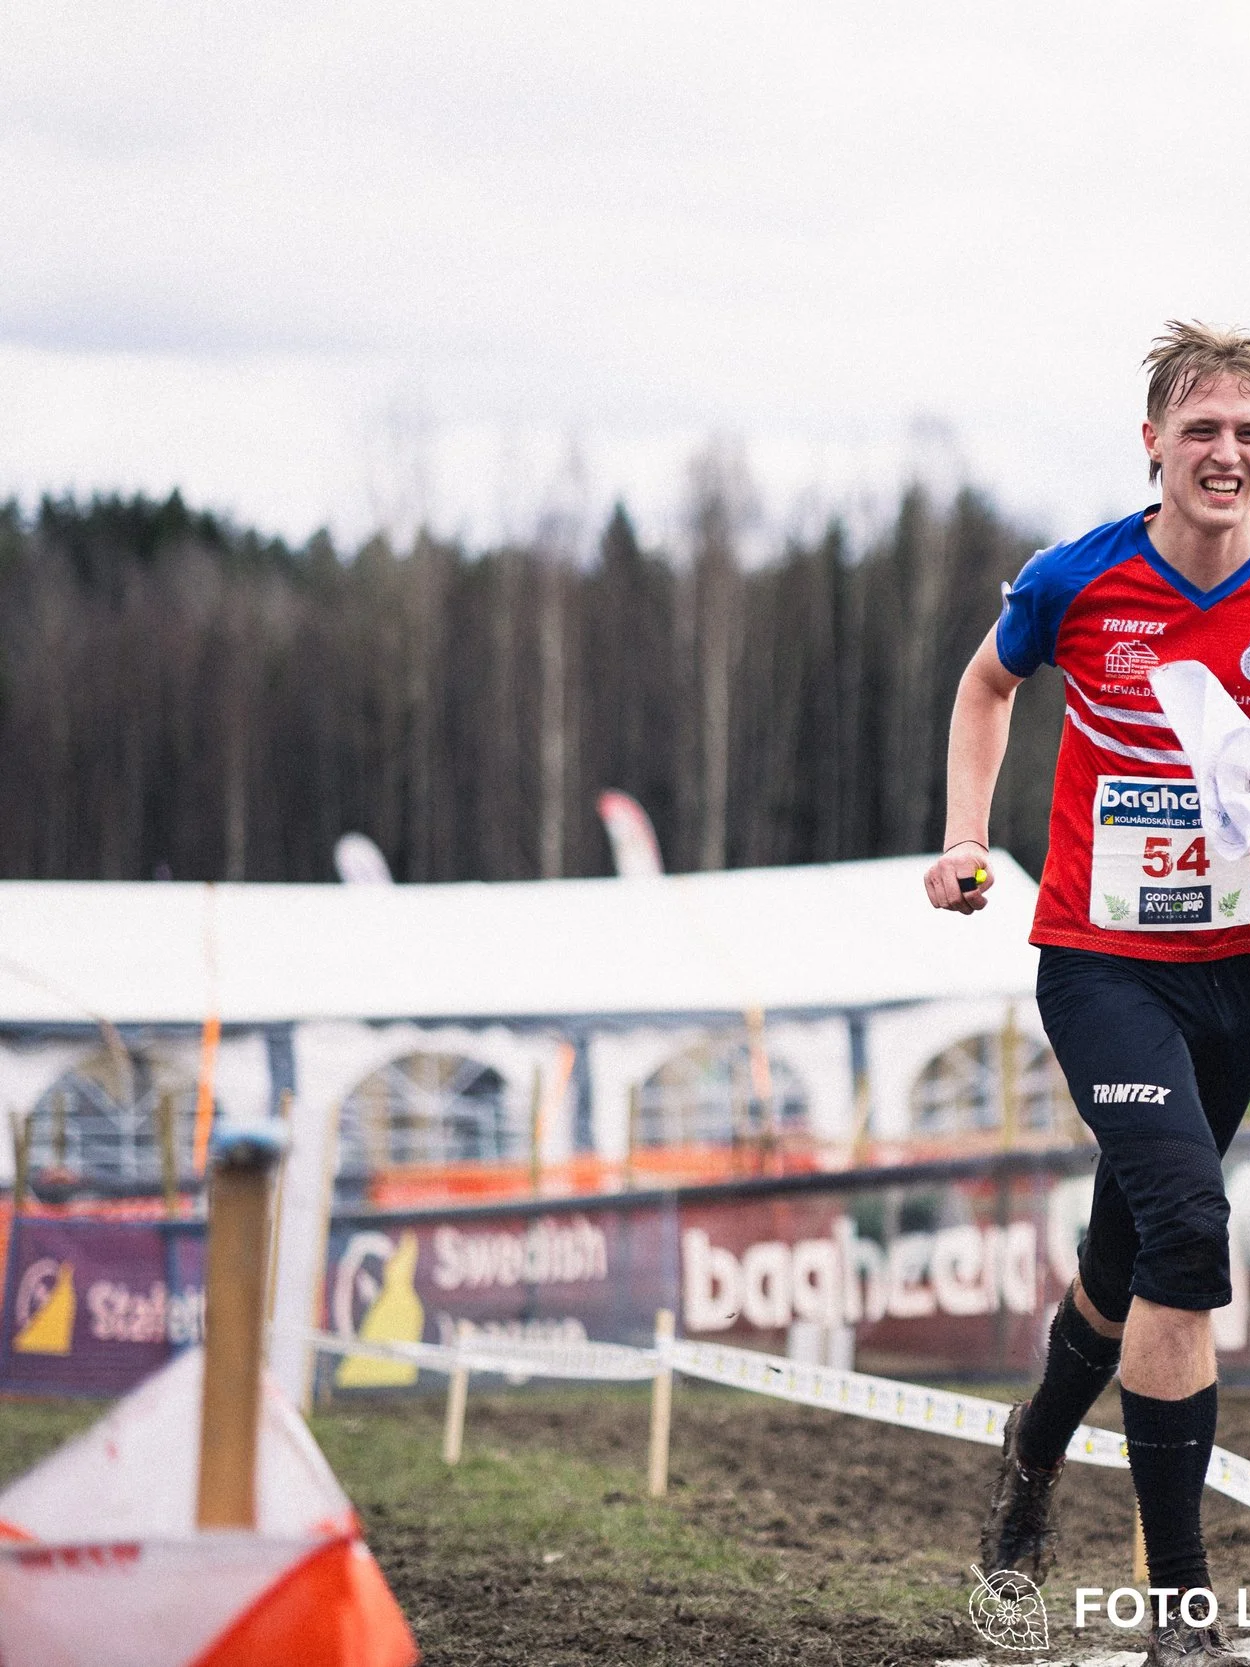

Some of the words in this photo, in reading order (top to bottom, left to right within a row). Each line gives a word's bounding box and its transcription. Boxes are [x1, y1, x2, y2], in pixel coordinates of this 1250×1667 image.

[1102, 618, 1168, 635] TRIMTEX
[1101, 785, 1200, 813] baghe
[1114, 815, 1186, 827] KOLMÅRDSKAVLEN
[1142, 836, 1210, 878] 54
[1145, 891, 1205, 902] GODKÄNDA
[1145, 899, 1204, 912] AVLOPP
[1093, 1083, 1172, 1105] TRIMTEX
